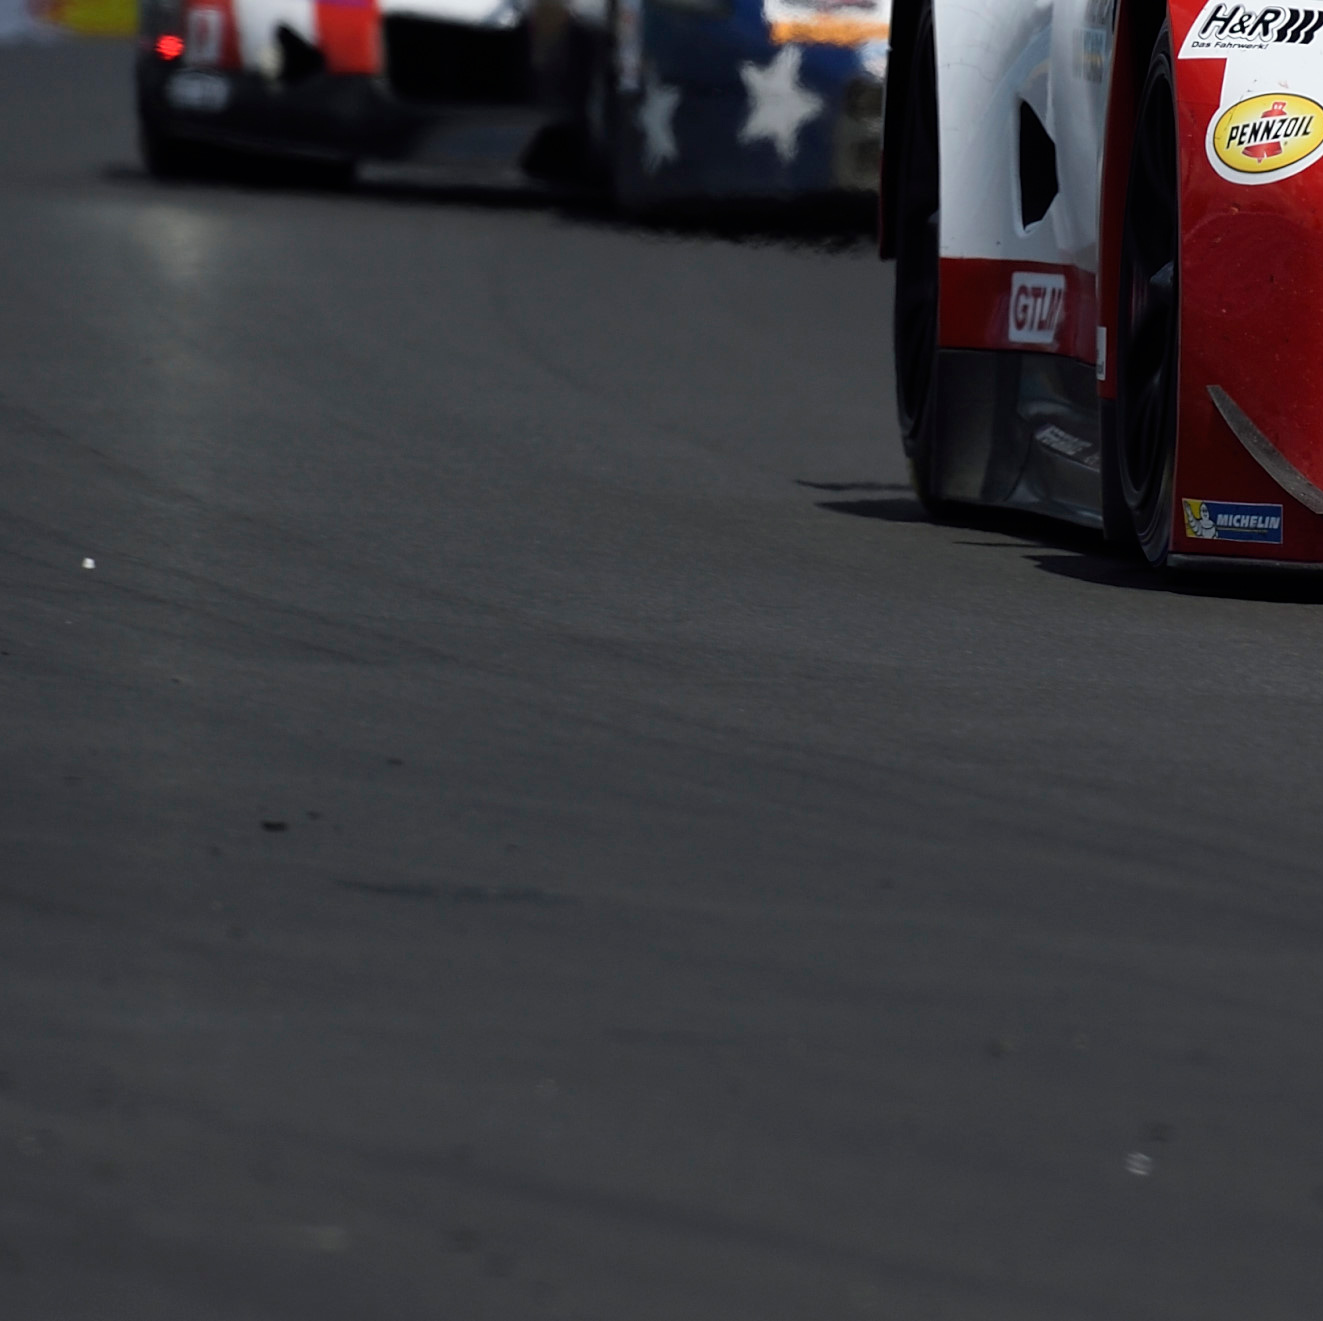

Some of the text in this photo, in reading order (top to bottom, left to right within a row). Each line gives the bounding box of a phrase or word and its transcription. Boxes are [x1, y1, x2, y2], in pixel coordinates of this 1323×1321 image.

[1199, 3, 1285, 42] H&R
[1191, 41, 1212, 49] Das
[1225, 116, 1314, 150] PENNZOIL
[1216, 514, 1281, 529] MICHELIN
